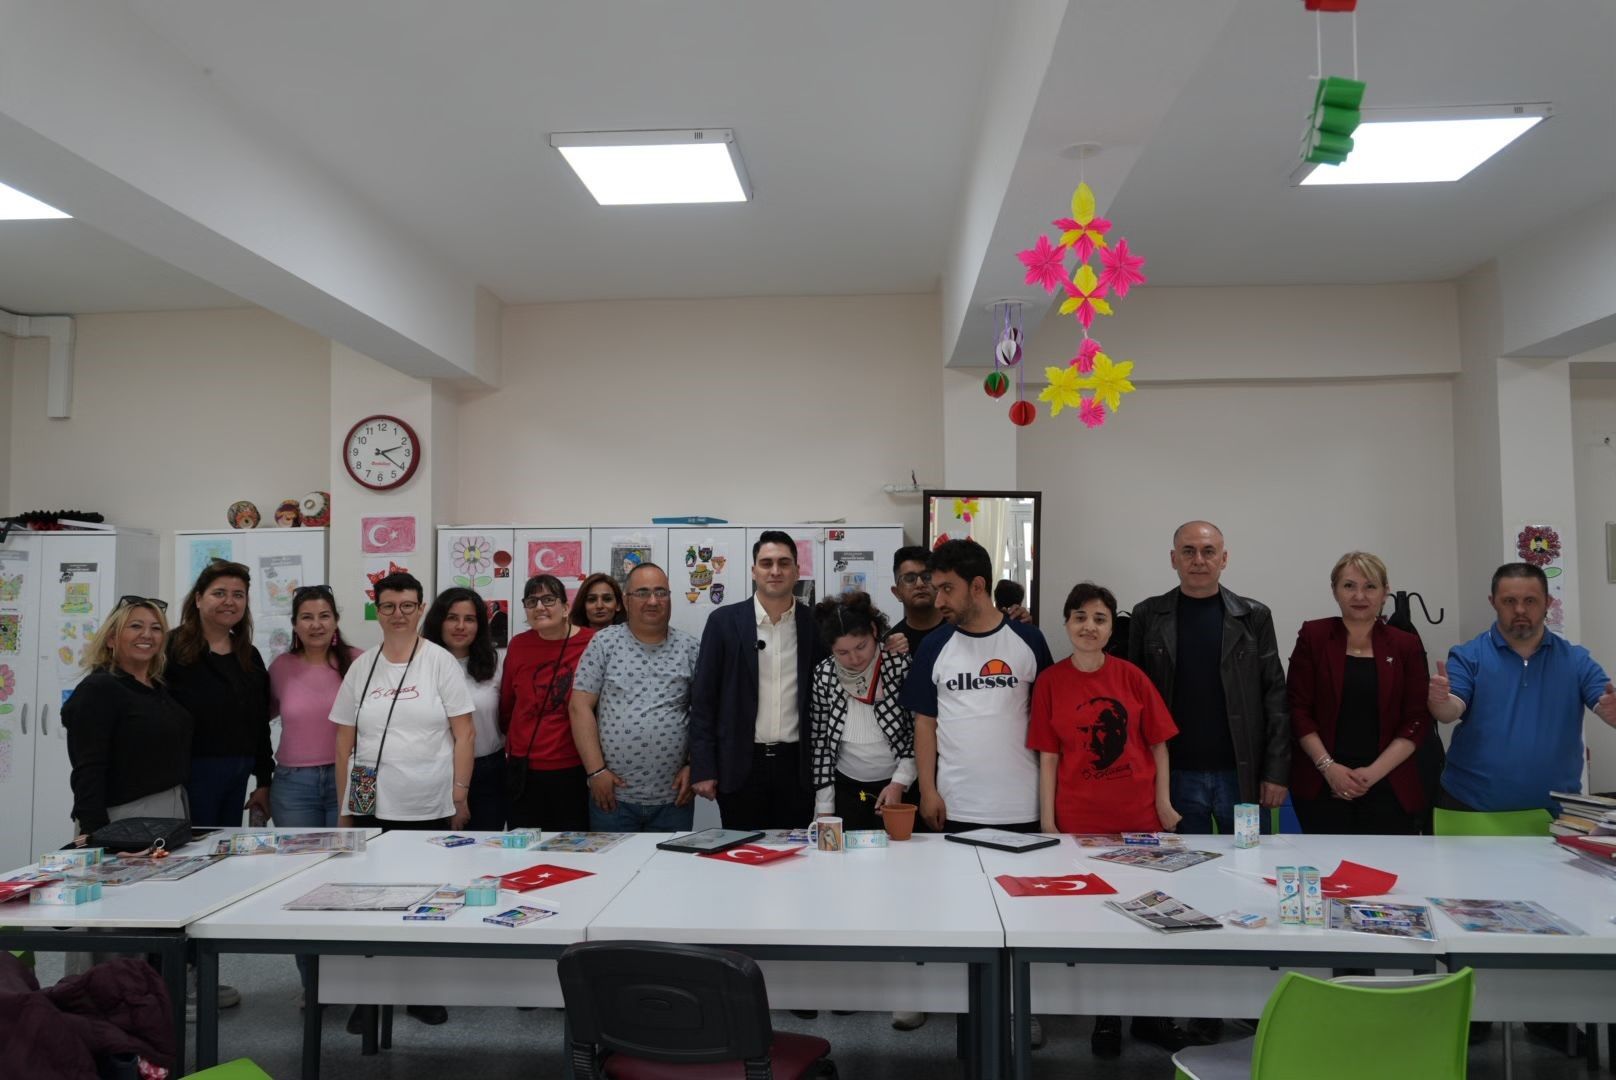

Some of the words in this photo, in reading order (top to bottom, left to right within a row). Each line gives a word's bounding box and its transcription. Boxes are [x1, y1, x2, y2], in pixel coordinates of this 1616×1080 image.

[366, 427, 373, 435] 11
[377, 423, 387, 431] 12
[357, 436, 367, 445] 10
[401, 437, 407, 445] 2
[352, 448, 359, 456] 9
[404, 449, 411, 457] 3
[356, 461, 362, 469] 8
[365, 469, 371, 478] 7
[377, 473, 383, 481] 6
[391, 470, 397, 478] 5
[946, 673, 1018, 691] ellesse
